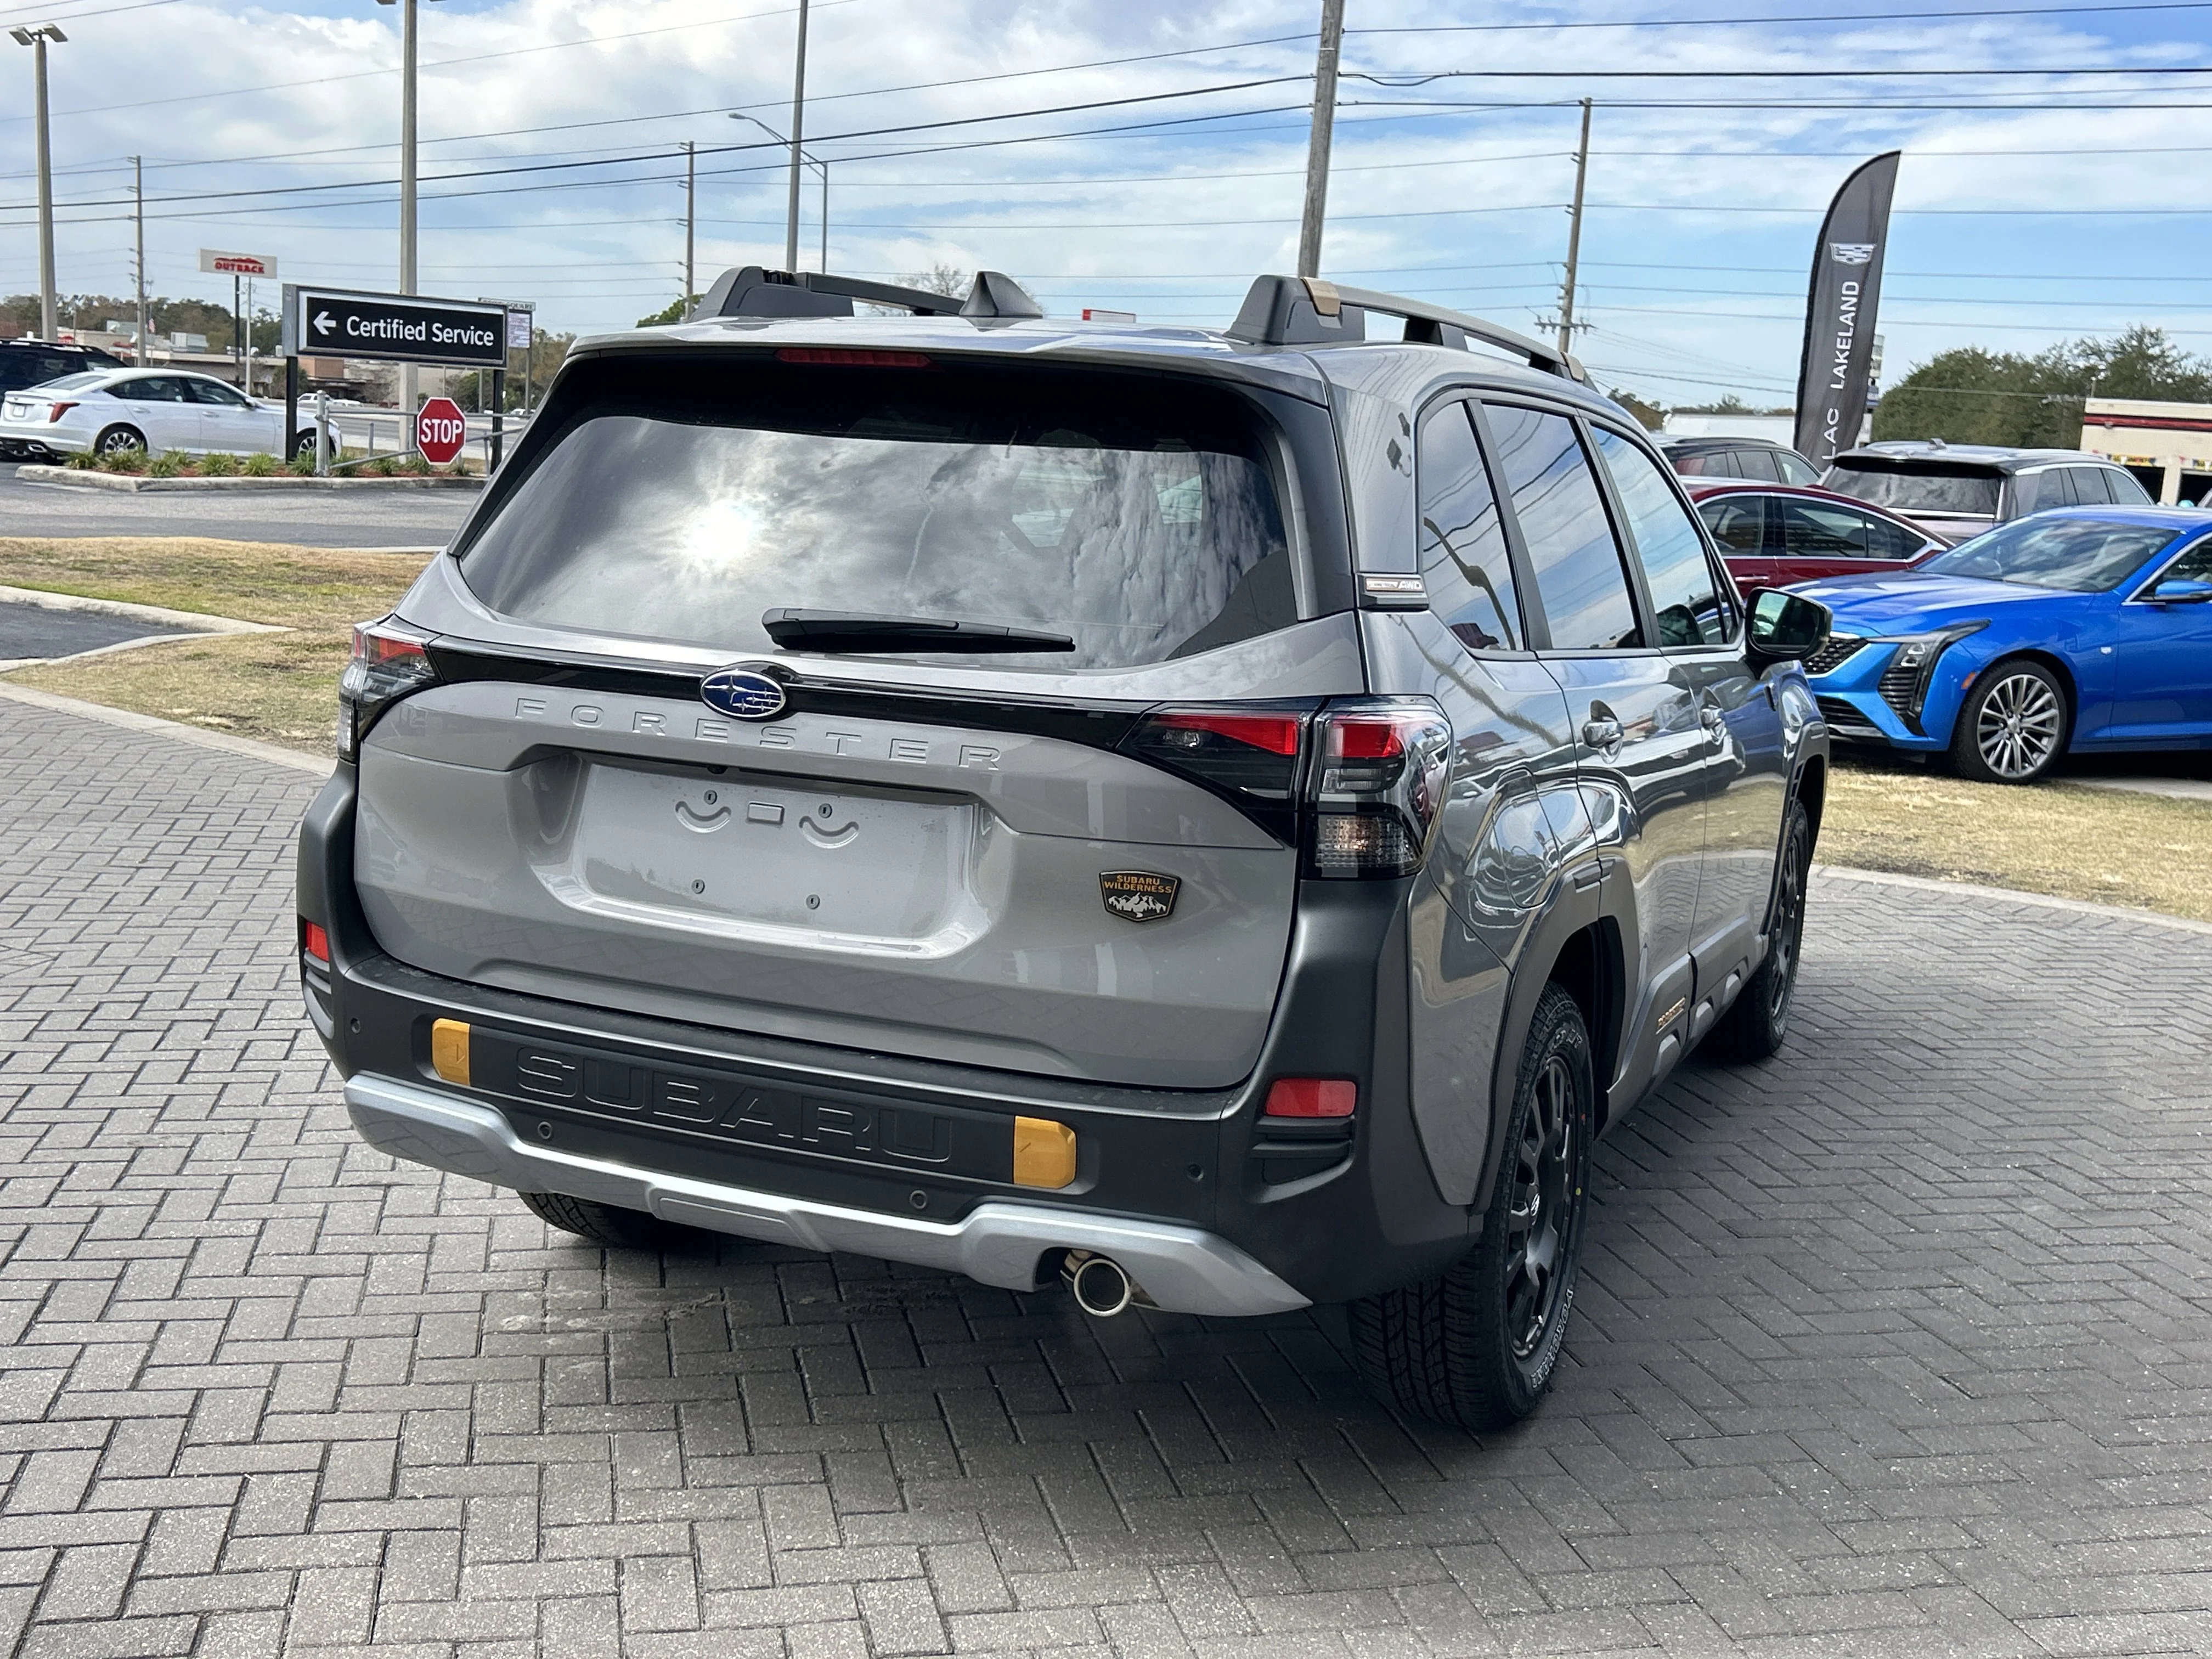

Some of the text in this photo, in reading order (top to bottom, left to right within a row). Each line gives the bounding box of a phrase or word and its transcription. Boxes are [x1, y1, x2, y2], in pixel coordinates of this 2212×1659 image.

[215, 262, 265, 274] OUTBACK
[346, 315, 426, 341] Certified
[432, 323, 494, 347] Service
[1830, 281, 1859, 390] LAKELAND
[421, 418, 463, 444] STOP
[1821, 408, 1839, 460] LAC
[1398, 580, 1423, 590] AWD
[515, 697, 1002, 770] FORESTER
[1104, 881, 1172, 894] WILDERNESS
[1116, 875, 1160, 885] SUBARU
[516, 1046, 952, 1164] SUBARU
[1531, 1288, 1574, 1389] YOKOHAMA
